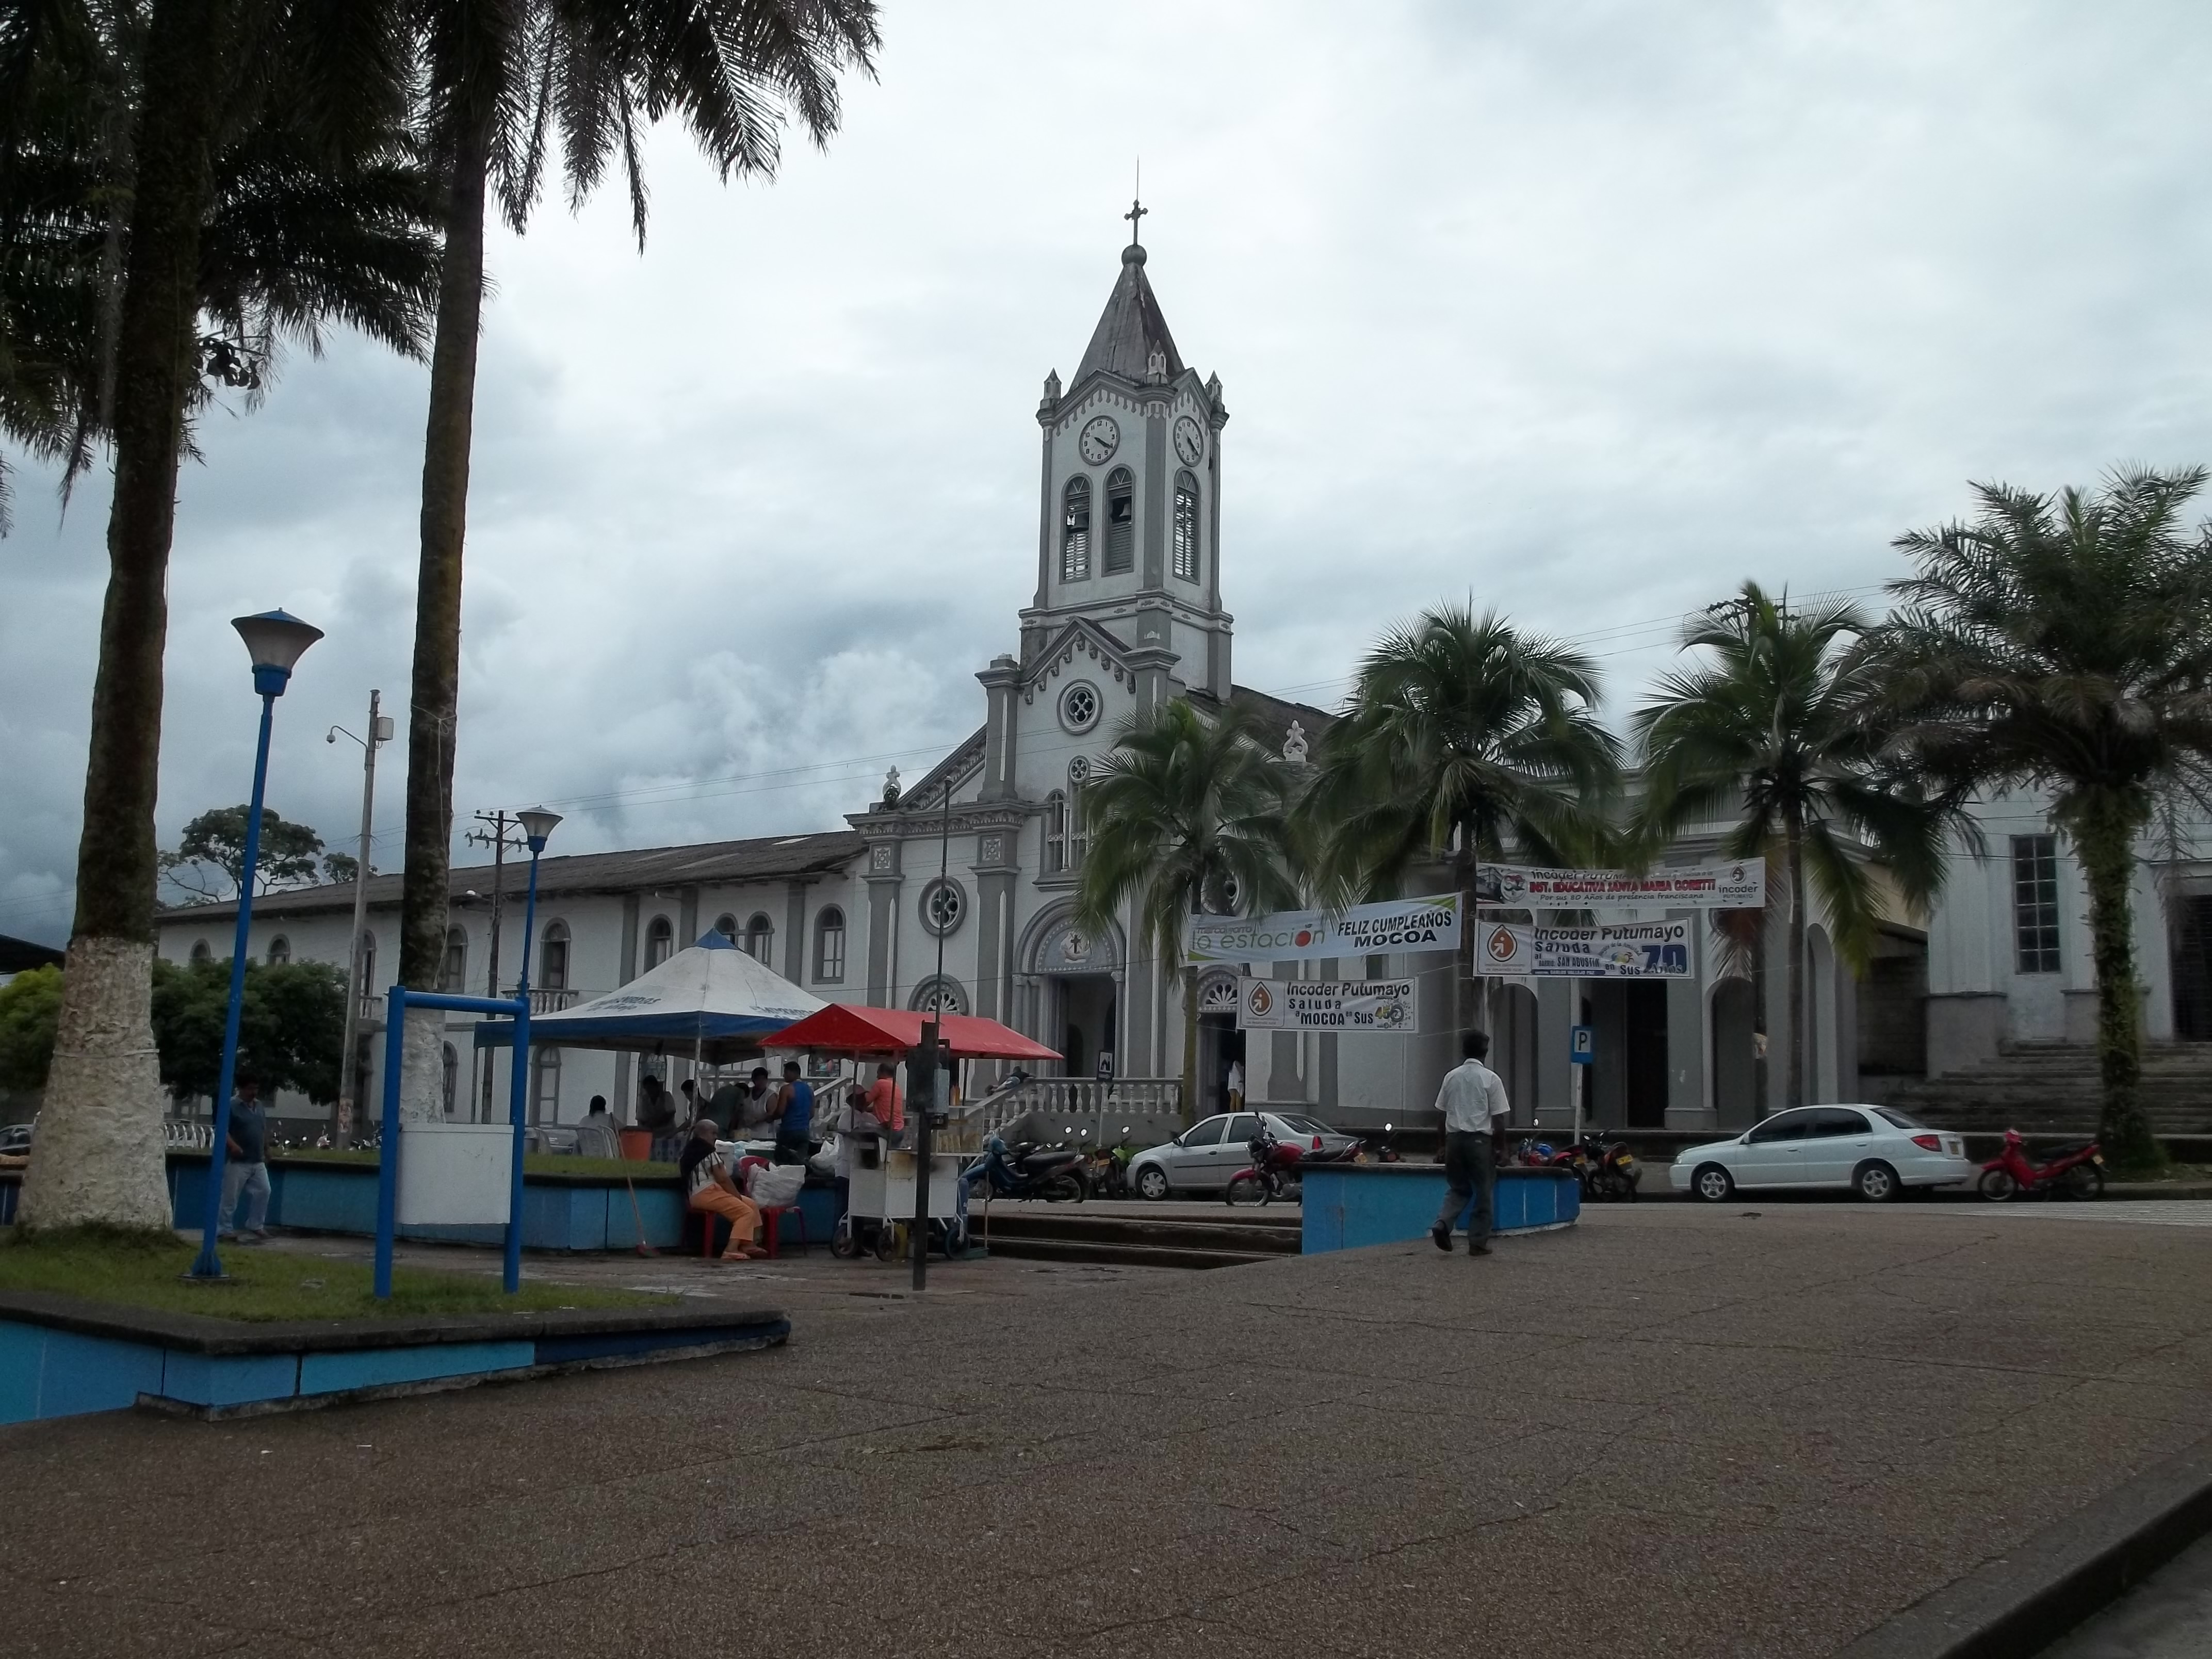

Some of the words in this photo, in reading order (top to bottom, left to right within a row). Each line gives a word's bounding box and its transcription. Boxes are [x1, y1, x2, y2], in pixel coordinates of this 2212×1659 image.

[1553, 881, 1605, 893] EDUCATIVA
[1608, 880, 1638, 893] SANTA
[1718, 884, 1759, 893] incoder
[1617, 893, 1654, 901] presencia
[1338, 920, 1370, 937] FELIZ
[1372, 909, 1452, 934] CUMPLEAÑOS
[1192, 930, 1211, 950] la
[1354, 930, 1437, 948] MOCOA
[1534, 927, 1598, 940] Incoder
[1602, 925, 1684, 942] Putumayo
[1534, 941, 1590, 953] Saluda
[1557, 957, 1570, 967] SAN
[1620, 964, 1640, 975] Sus
[1641, 944, 1687, 974] 70
[1287, 981, 1339, 996] Incoder
[1342, 982, 1410, 999] Putumayo
[1288, 998, 1341, 1010] Saluda
[1300, 1013, 1345, 1025] MOCOA
[1354, 1012, 1373, 1024] Sus
[1578, 1031, 1588, 1051] P
